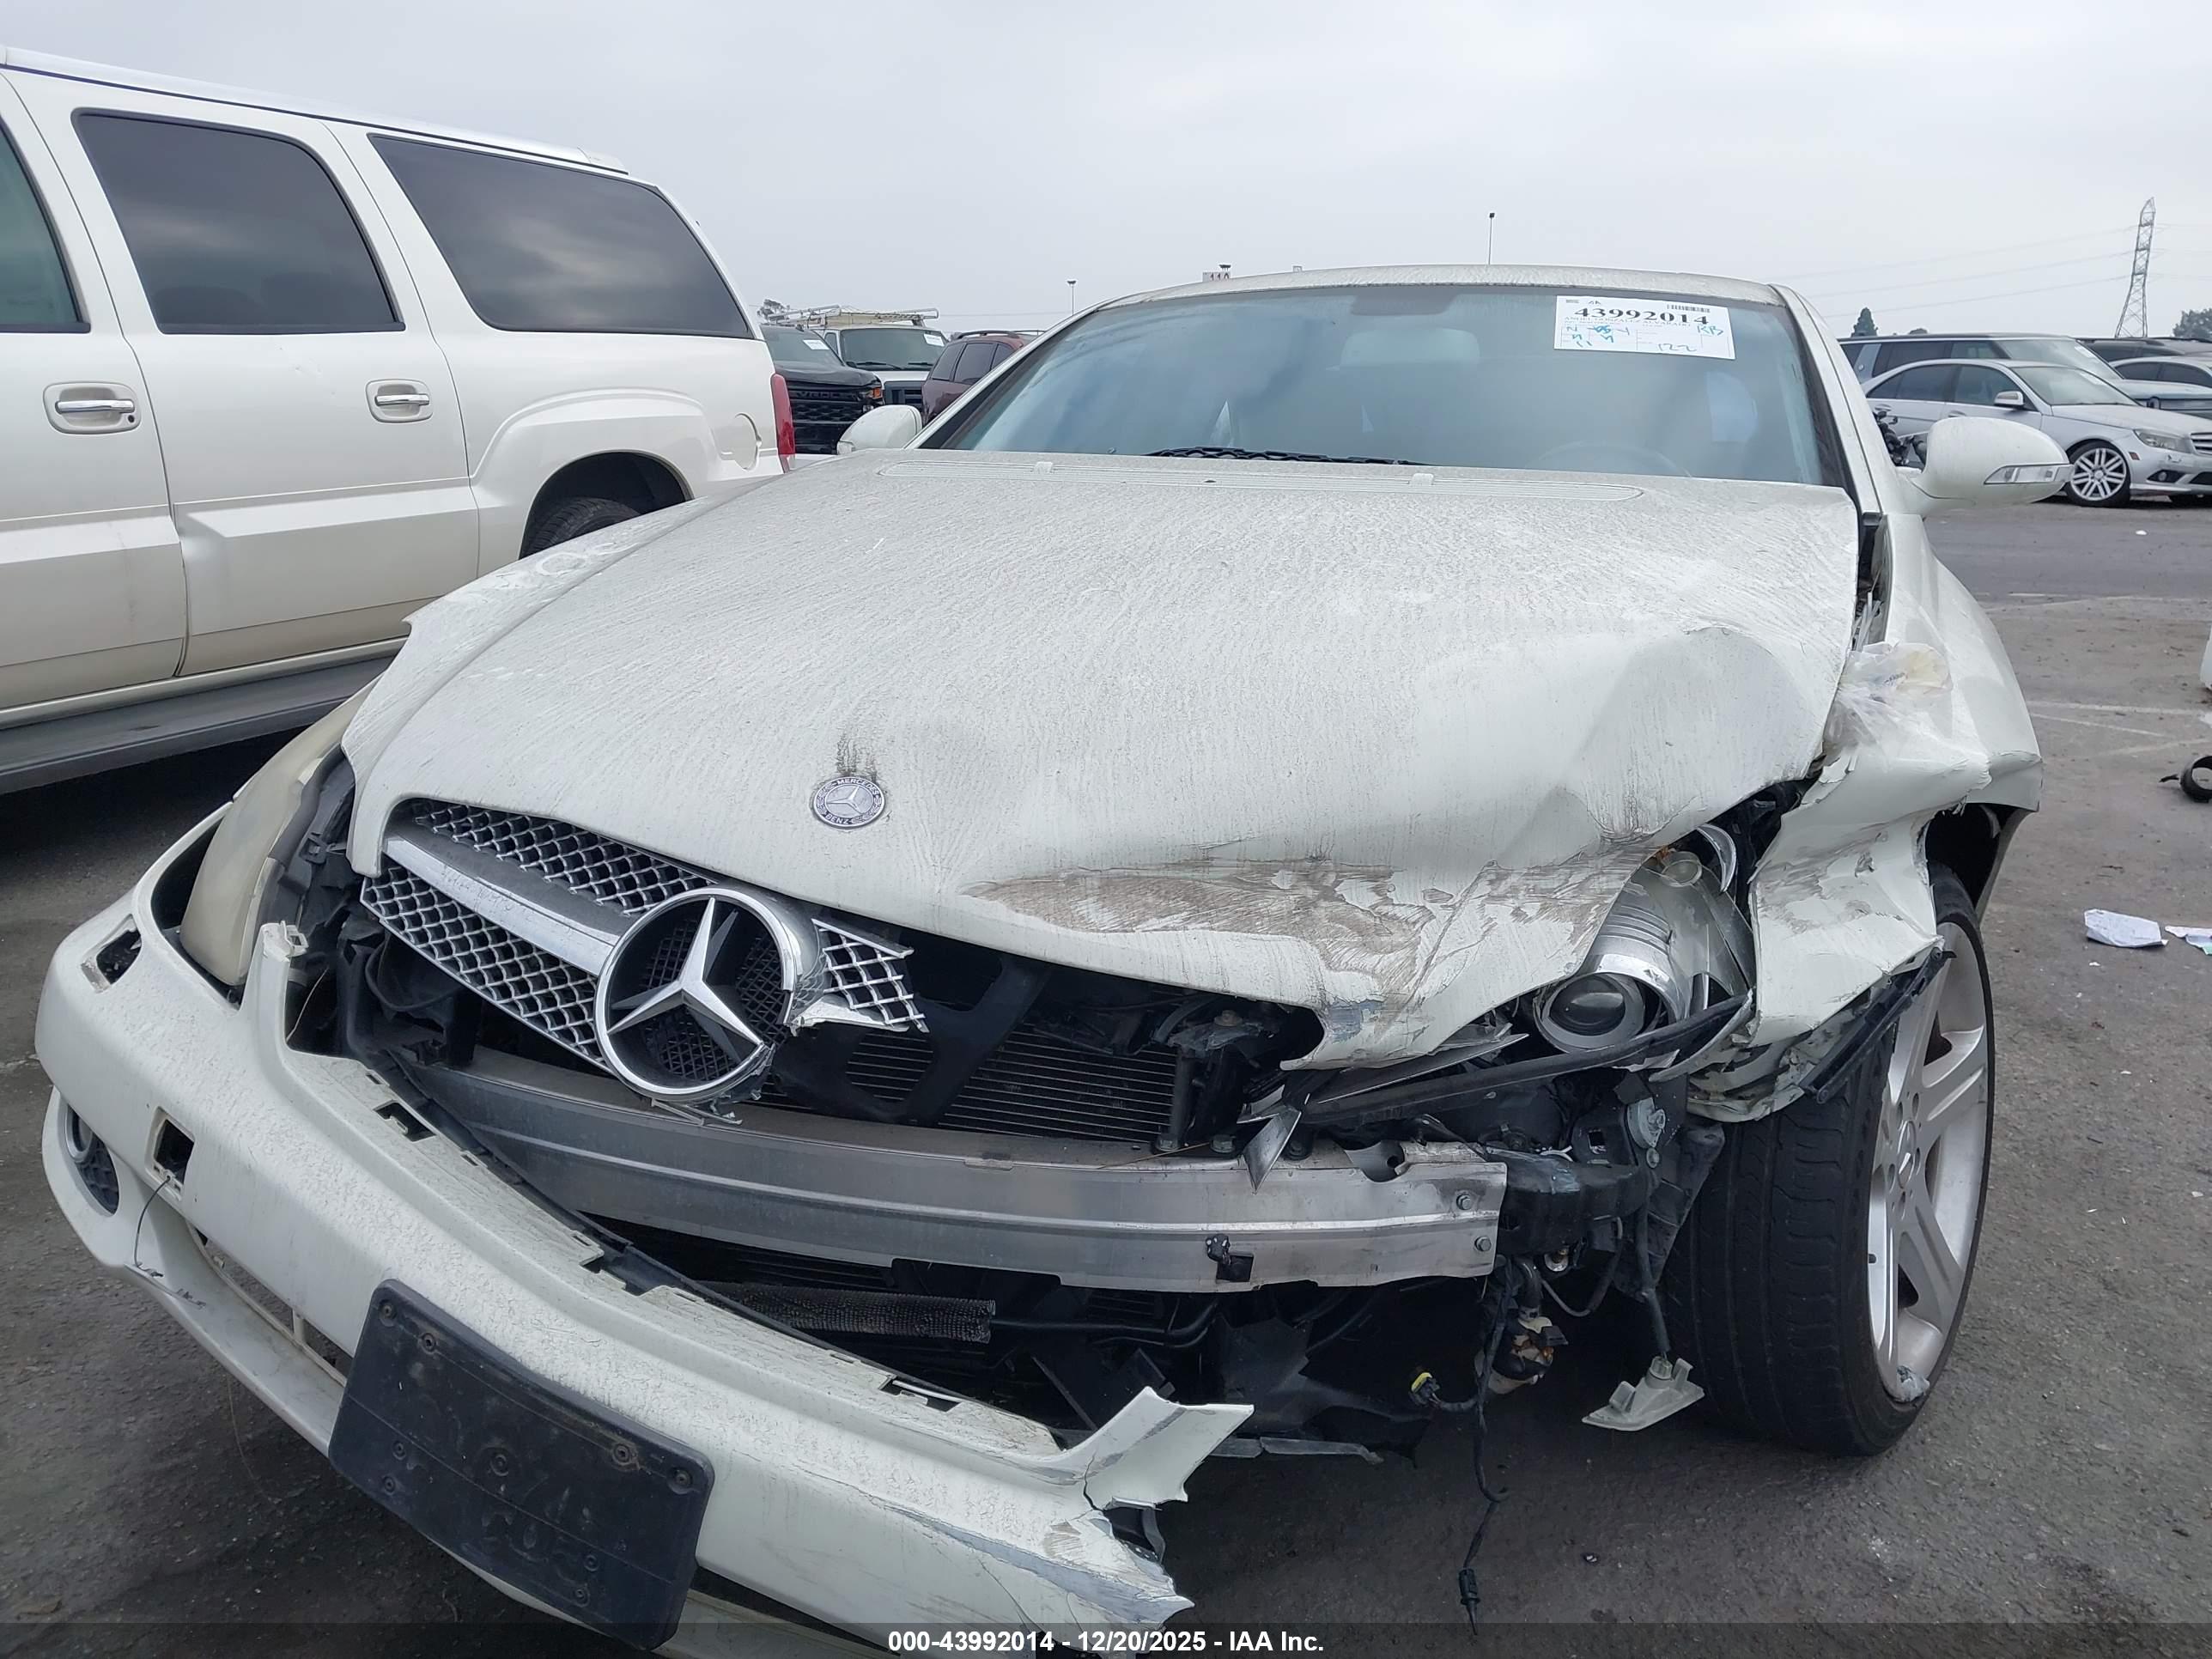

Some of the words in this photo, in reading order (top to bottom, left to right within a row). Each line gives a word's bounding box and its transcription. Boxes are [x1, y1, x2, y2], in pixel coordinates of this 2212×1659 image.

[1574, 307, 1708, 325] 43992014
[837, 779, 879, 795] MERCEDES
[825, 814, 848, 824] BENZ
